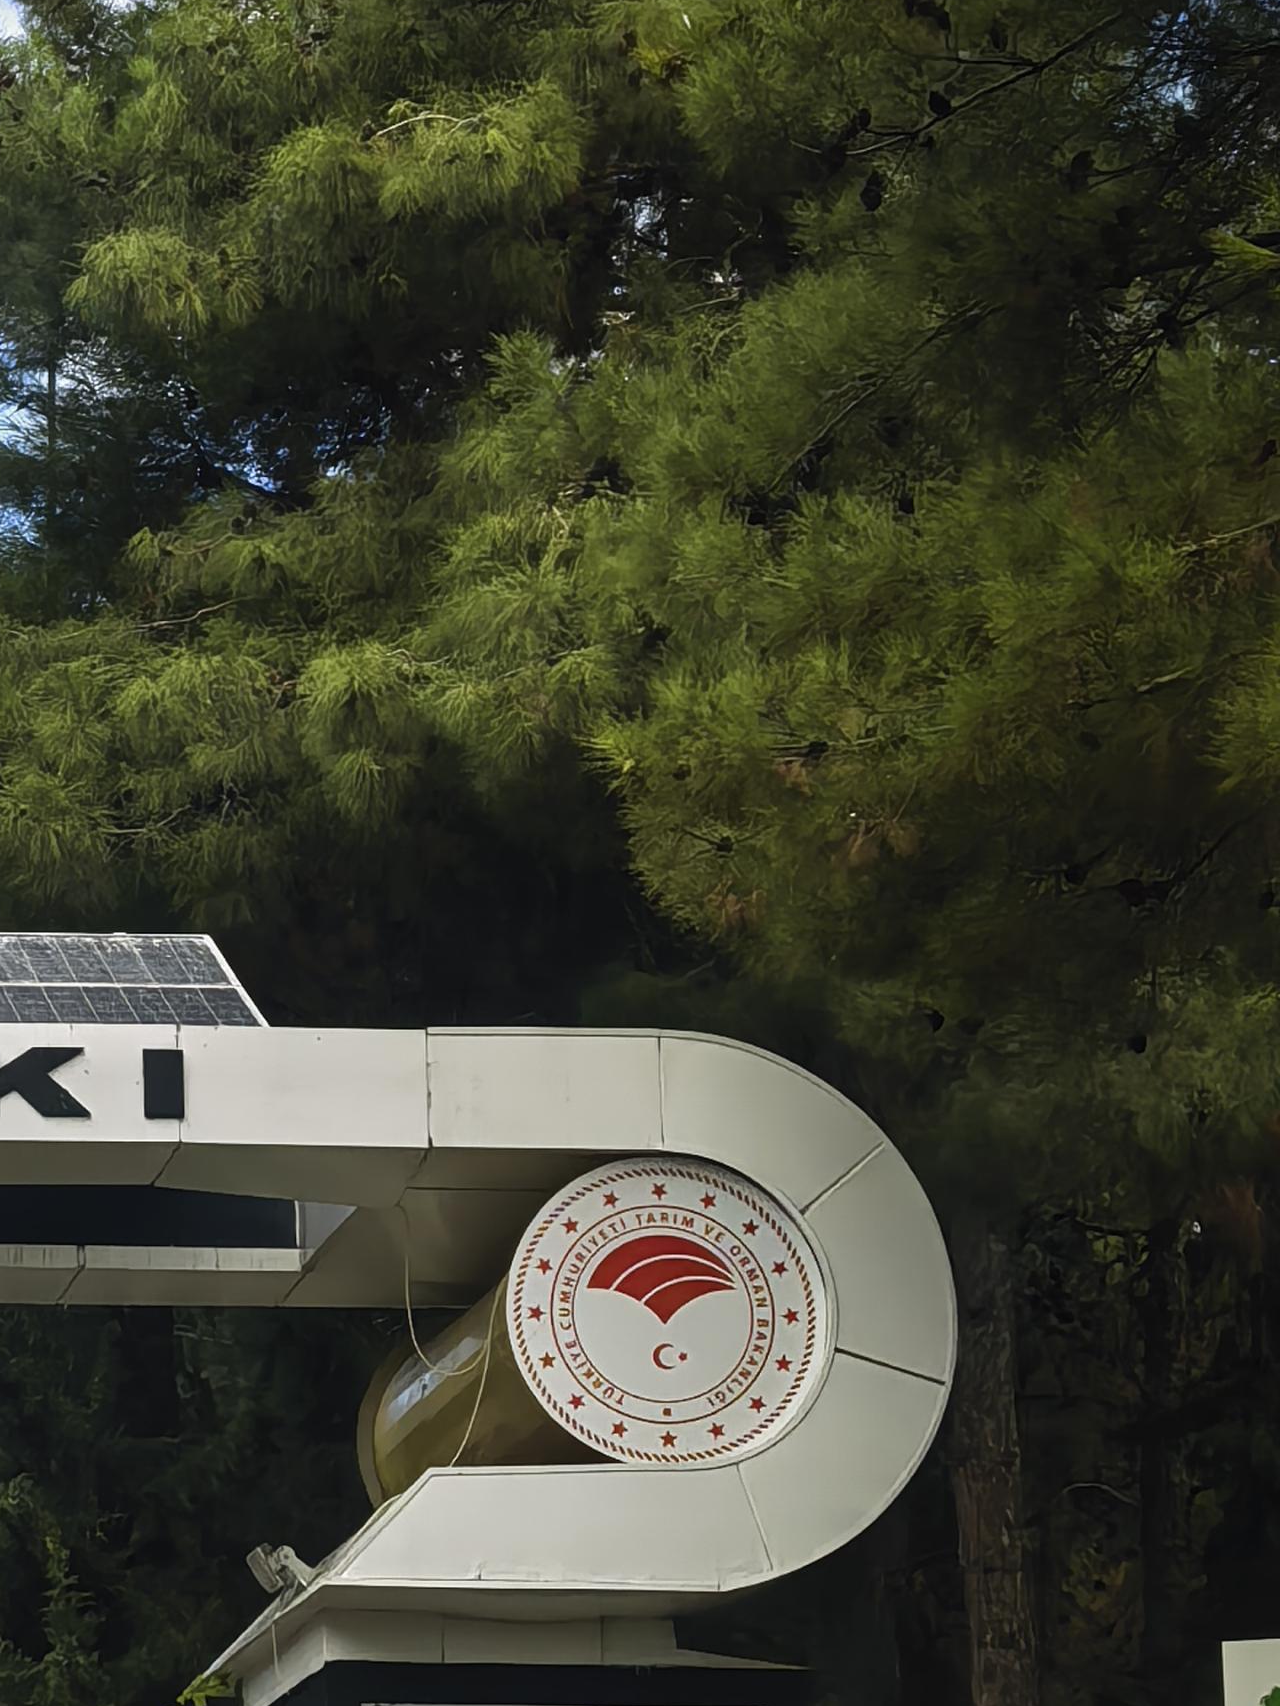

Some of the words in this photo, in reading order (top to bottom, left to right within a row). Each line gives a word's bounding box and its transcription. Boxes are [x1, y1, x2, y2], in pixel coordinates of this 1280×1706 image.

[558, 1217, 626, 1330] CUMHURİYETİ
[635, 1212, 695, 1229] TARIM
[703, 1224, 725, 1243] VE
[730, 1244, 768, 1308] ORMAN
